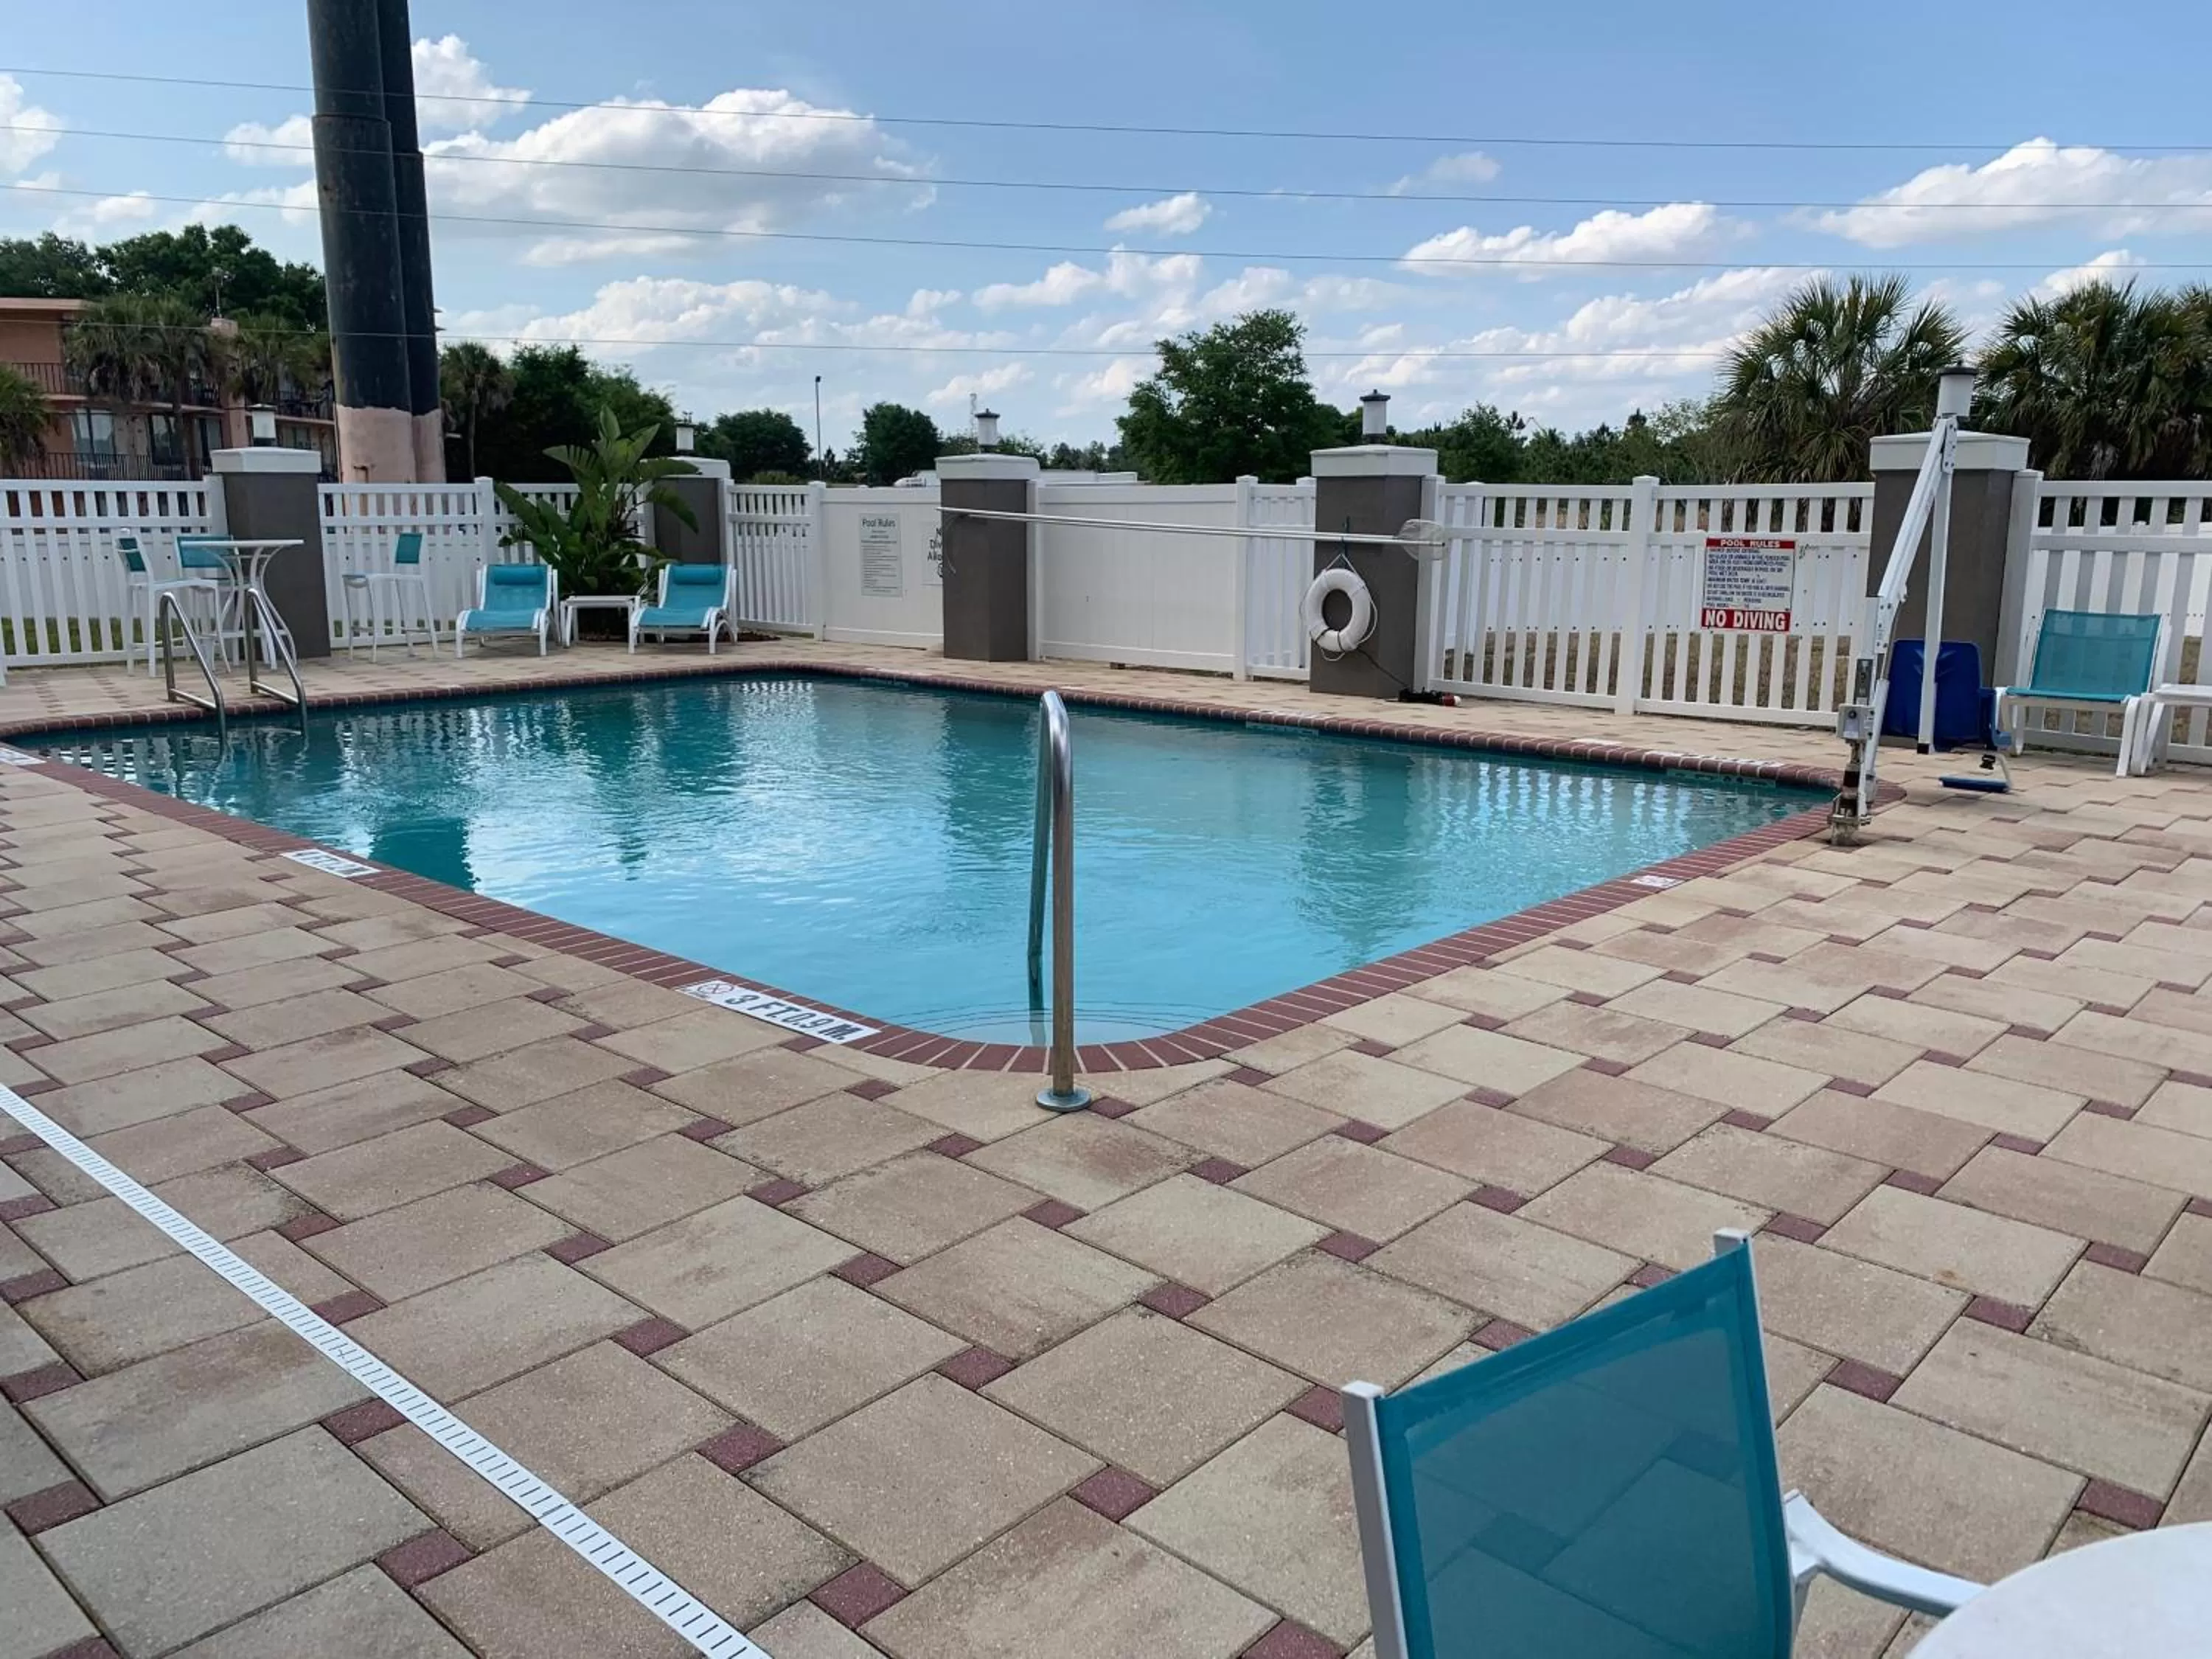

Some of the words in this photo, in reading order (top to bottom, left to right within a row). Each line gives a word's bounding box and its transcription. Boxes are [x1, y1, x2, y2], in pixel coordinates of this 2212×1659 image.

[862, 518, 877, 528] Pool
[877, 518, 896, 528] Rules
[1749, 540, 1781, 548] RULES
[1705, 610, 1727, 627] NO
[1732, 611, 1785, 630] DIVING
[724, 994, 761, 1005] 3
